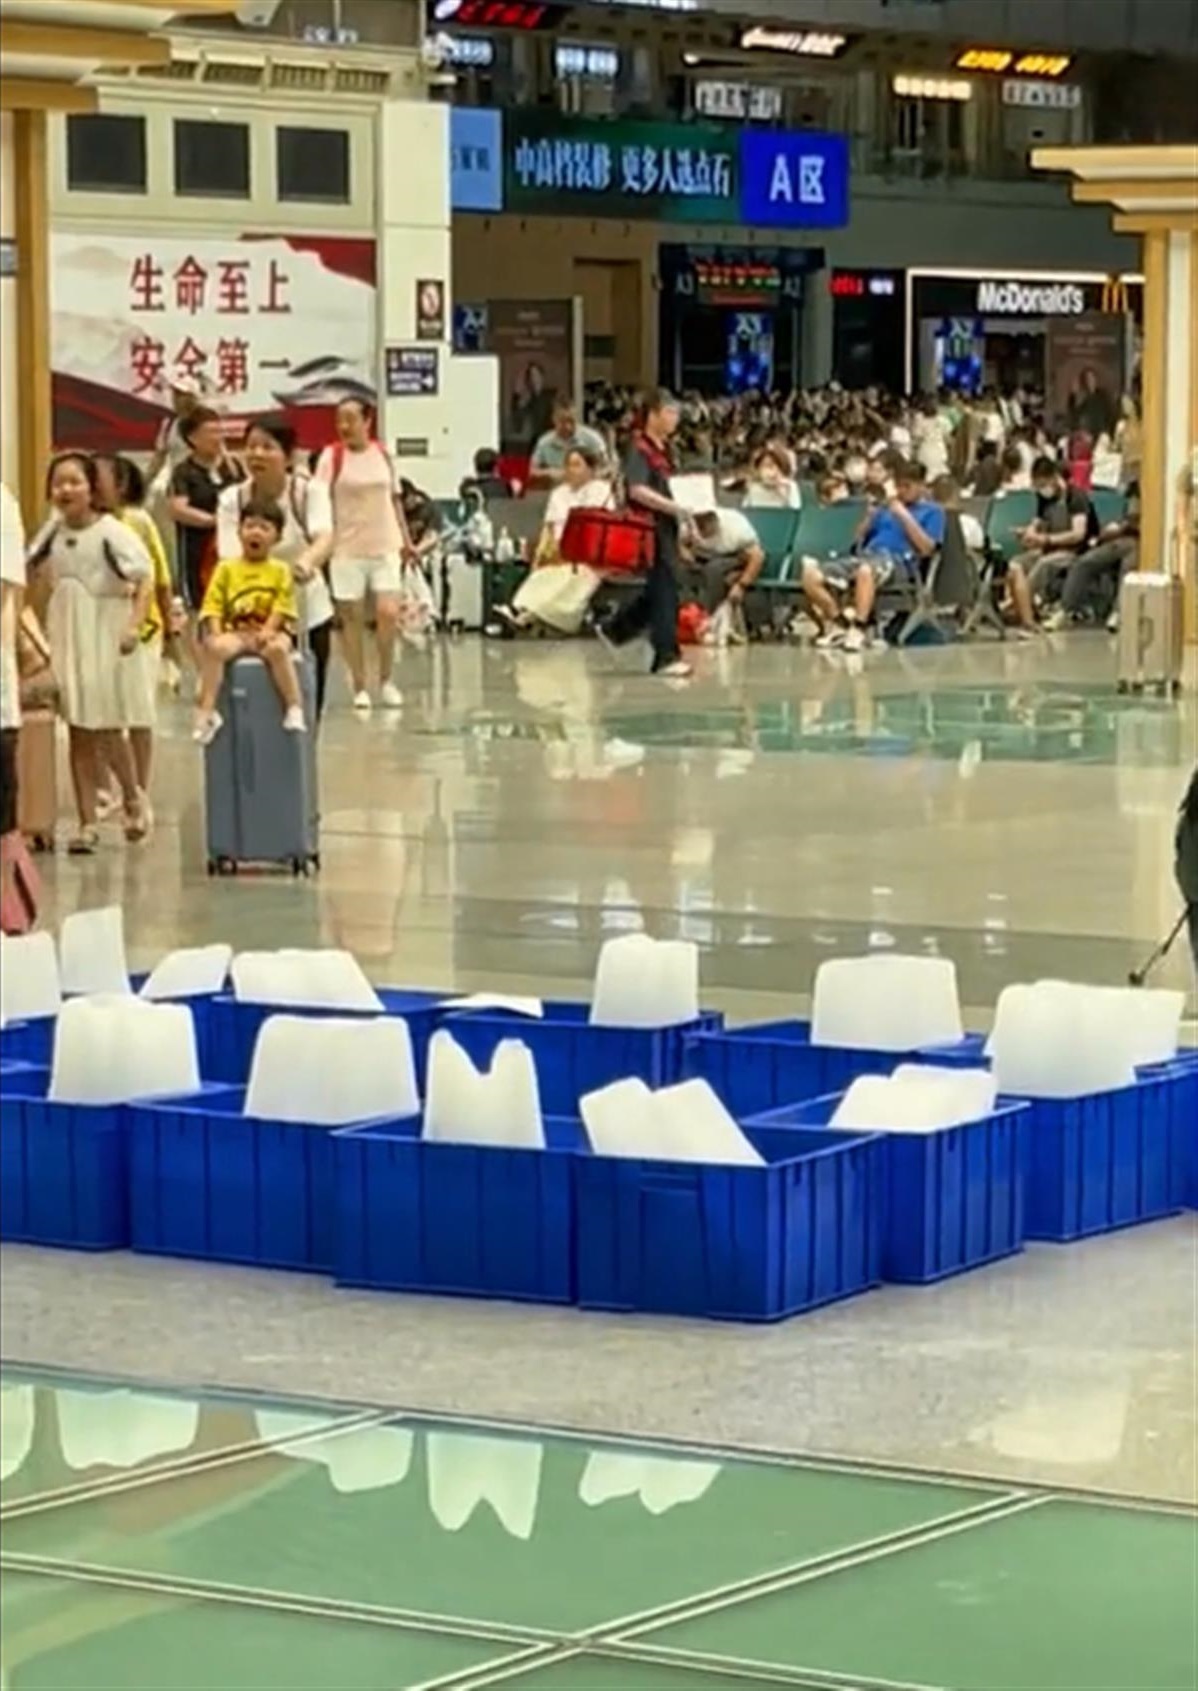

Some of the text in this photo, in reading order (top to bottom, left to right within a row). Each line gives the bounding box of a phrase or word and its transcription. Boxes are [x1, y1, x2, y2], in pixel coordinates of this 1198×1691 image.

[514, 138, 612, 190] 中高档装修
[621, 147, 732, 198] 更多人选点石
[130, 254, 292, 316] 生命至上
[976, 282, 1085, 315] McDonald's
[130, 336, 292, 393] 安全第一
